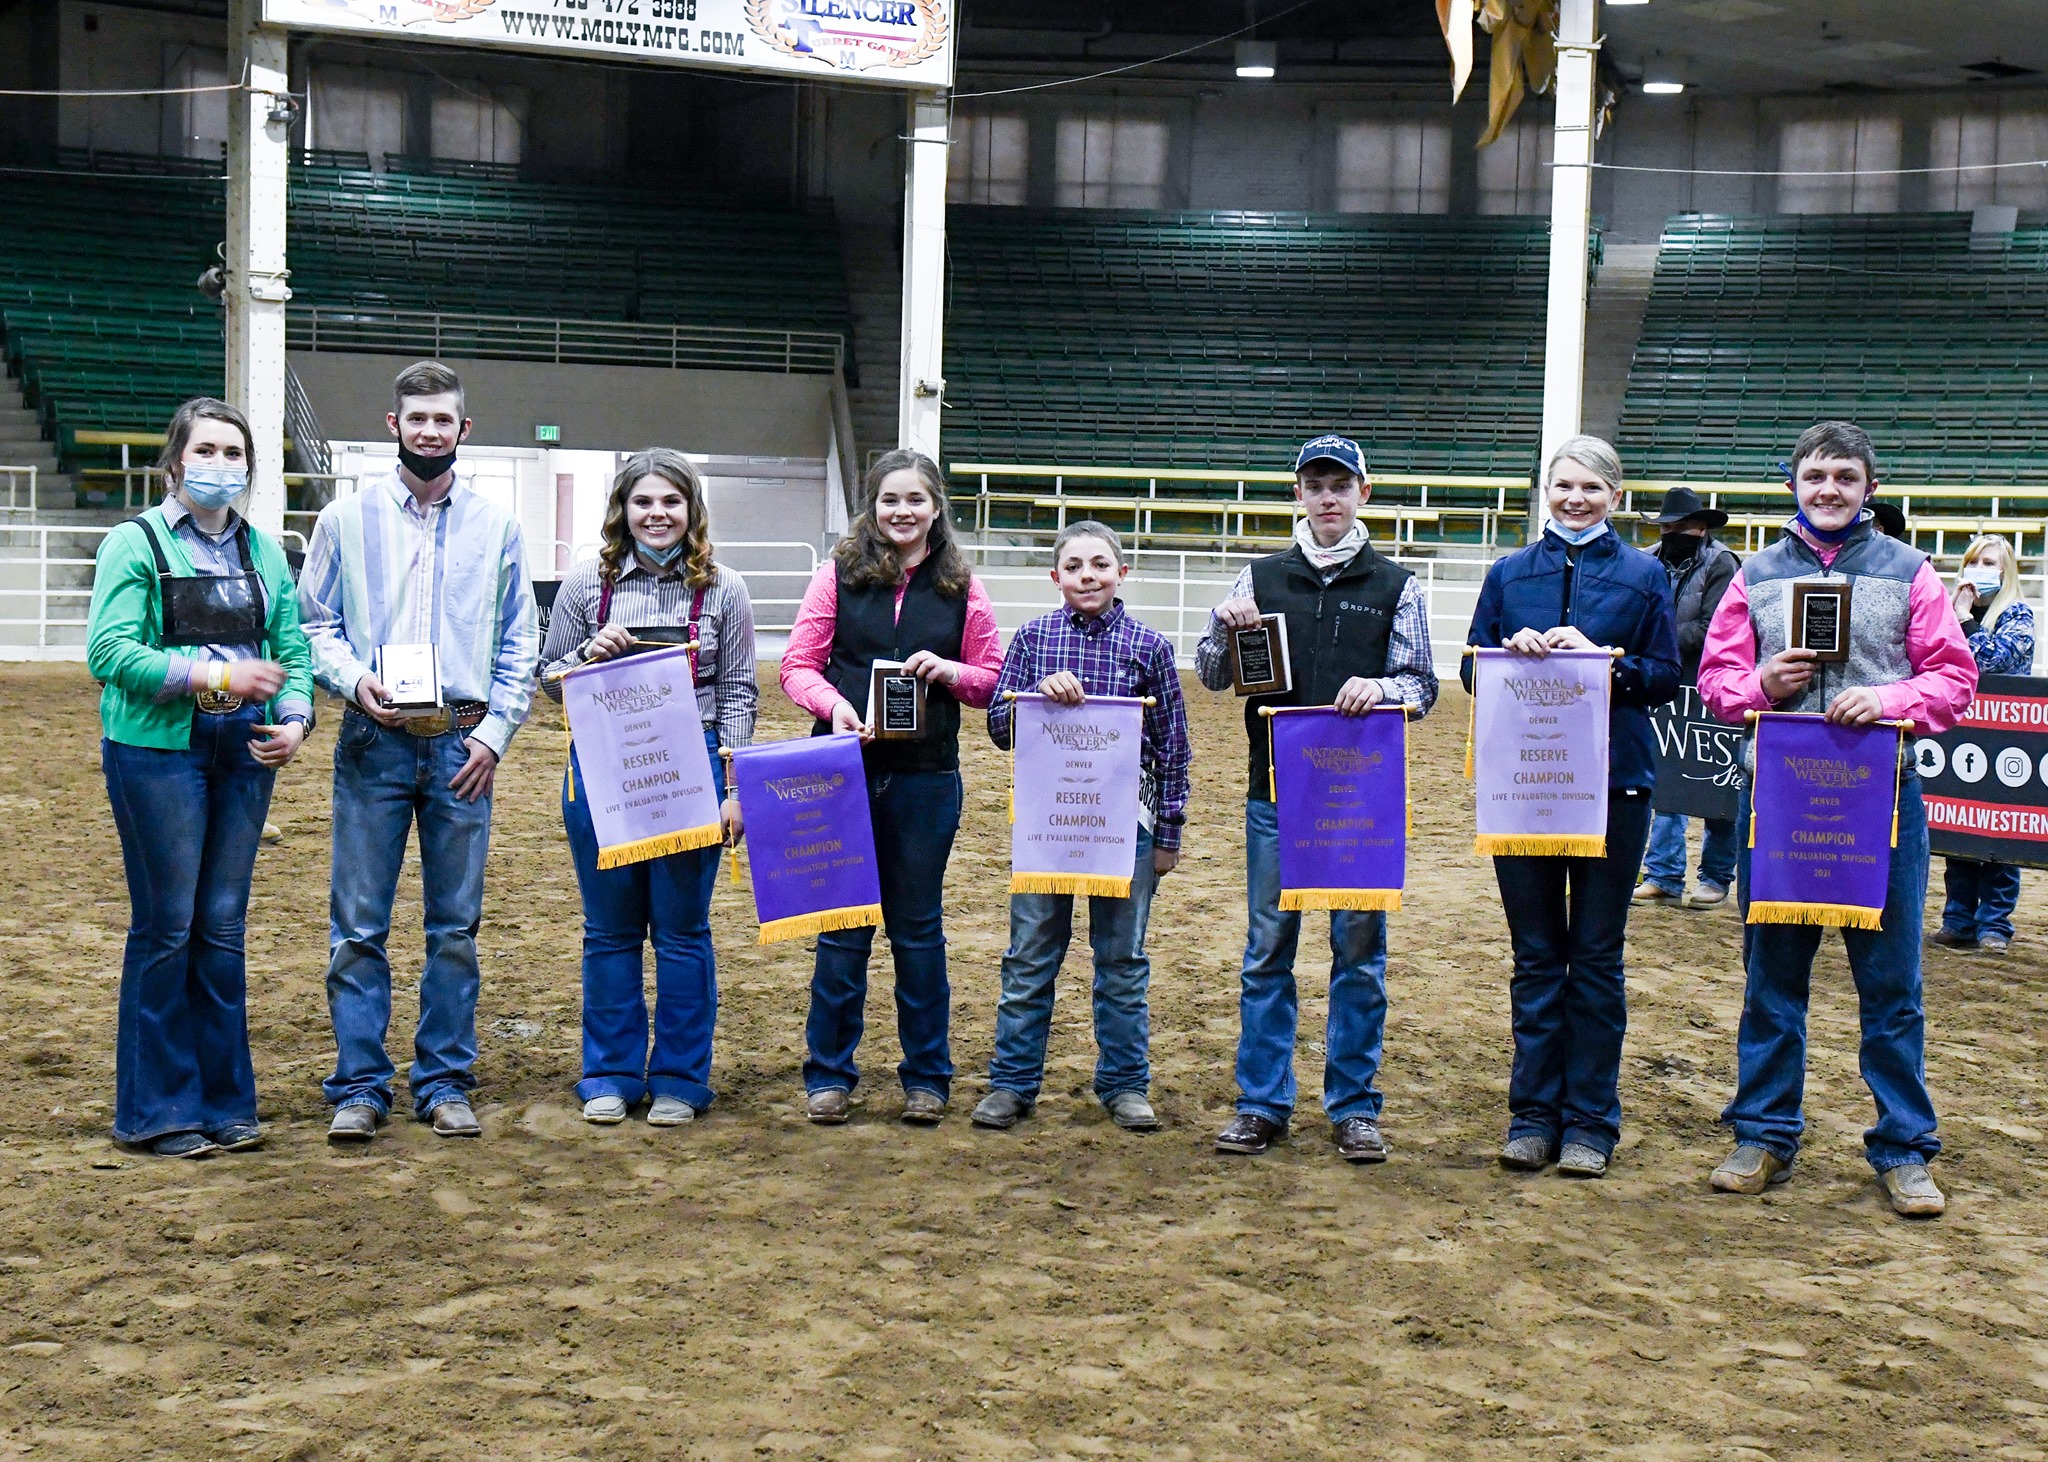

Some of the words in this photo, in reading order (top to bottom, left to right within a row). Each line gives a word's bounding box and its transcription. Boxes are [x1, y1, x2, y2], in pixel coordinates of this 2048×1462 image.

[781, 0, 917, 26] SILENCER
[540, 425, 557, 440] EXIT
[1350, 604, 1383, 616] ROPER
[1503, 677, 1567, 690] NATIONAL
[592, 684, 653, 705] NATIONAL
[1513, 688, 1574, 701] WESTERN
[604, 694, 662, 713] WESTERN
[624, 721, 652, 733] DENVER
[1529, 716, 1558, 725] DENVER
[1041, 721, 1101, 735] NATIONAL
[1051, 733, 1108, 745] WESTERN
[623, 749, 670, 770] RESERVE
[1520, 749, 1568, 762] RESERVE
[1065, 761, 1093, 769] DENVER
[1783, 756, 1850, 770] NATIONAL
[622, 769, 680, 793] CHAMPION
[1513, 771, 1574, 785] CHAMPION
[1795, 767, 1857, 782] WESTERN
[763, 773, 826, 793] NATIONAL
[776, 783, 833, 801] WESTERN
[1055, 791, 1102, 805] RESERVE
[1492, 792, 1507, 801] LIVE
[1511, 792, 1558, 801] EVALUATION
[1561, 792, 1595, 801] DIVISION
[605, 803, 621, 814] LIVE
[624, 793, 669, 810] EVALUATION
[671, 785, 703, 799] DIVISION
[1810, 797, 1840, 806] DENVER
[651, 810, 667, 820] 2021
[1536, 808, 1553, 817] 2021
[1048, 814, 1106, 828] CHAMPION
[1027, 834, 1043, 842] LIVE
[1046, 834, 1090, 843] EVALUATION
[1094, 835, 1125, 844] DIVISION
[1791, 830, 1856, 846] CHAMPION
[784, 839, 842, 860] CHAMPION
[1069, 850, 1084, 858] 2021
[1789, 851, 1837, 862] EVALUATION
[1841, 853, 1877, 864] DIVISION
[1814, 868, 1831, 878] 2021
